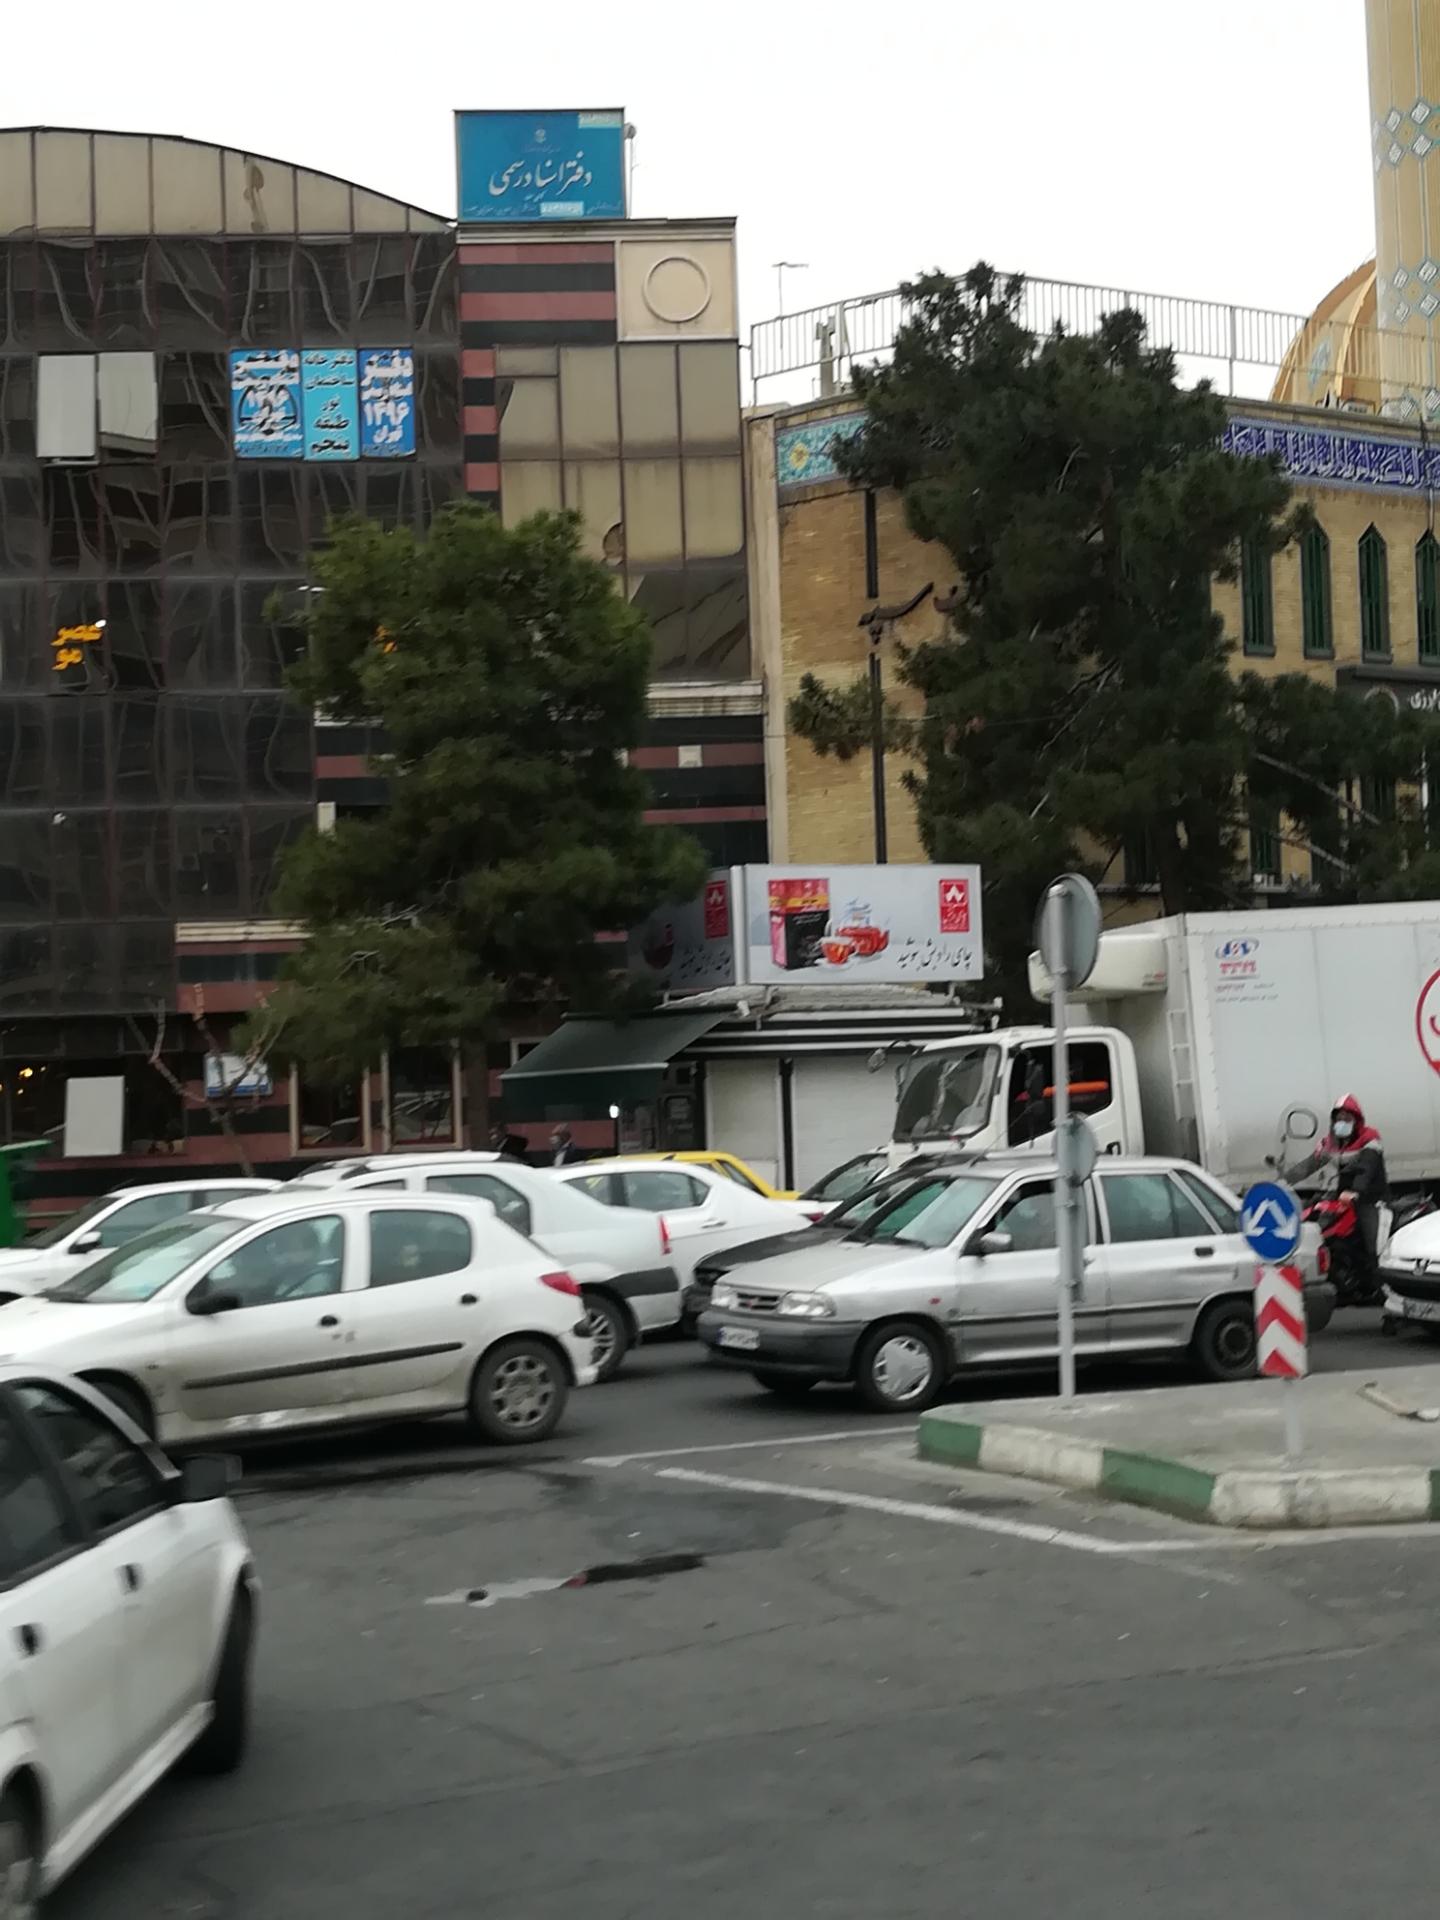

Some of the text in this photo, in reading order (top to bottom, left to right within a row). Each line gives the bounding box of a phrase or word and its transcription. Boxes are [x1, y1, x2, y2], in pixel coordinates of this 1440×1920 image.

[488, 150, 593, 196] دفتر اسناد رسمی
[360, 349, 414, 386] دفتر
[305, 374, 354, 390] ساختمان
[314, 412, 350, 430] طبقه
